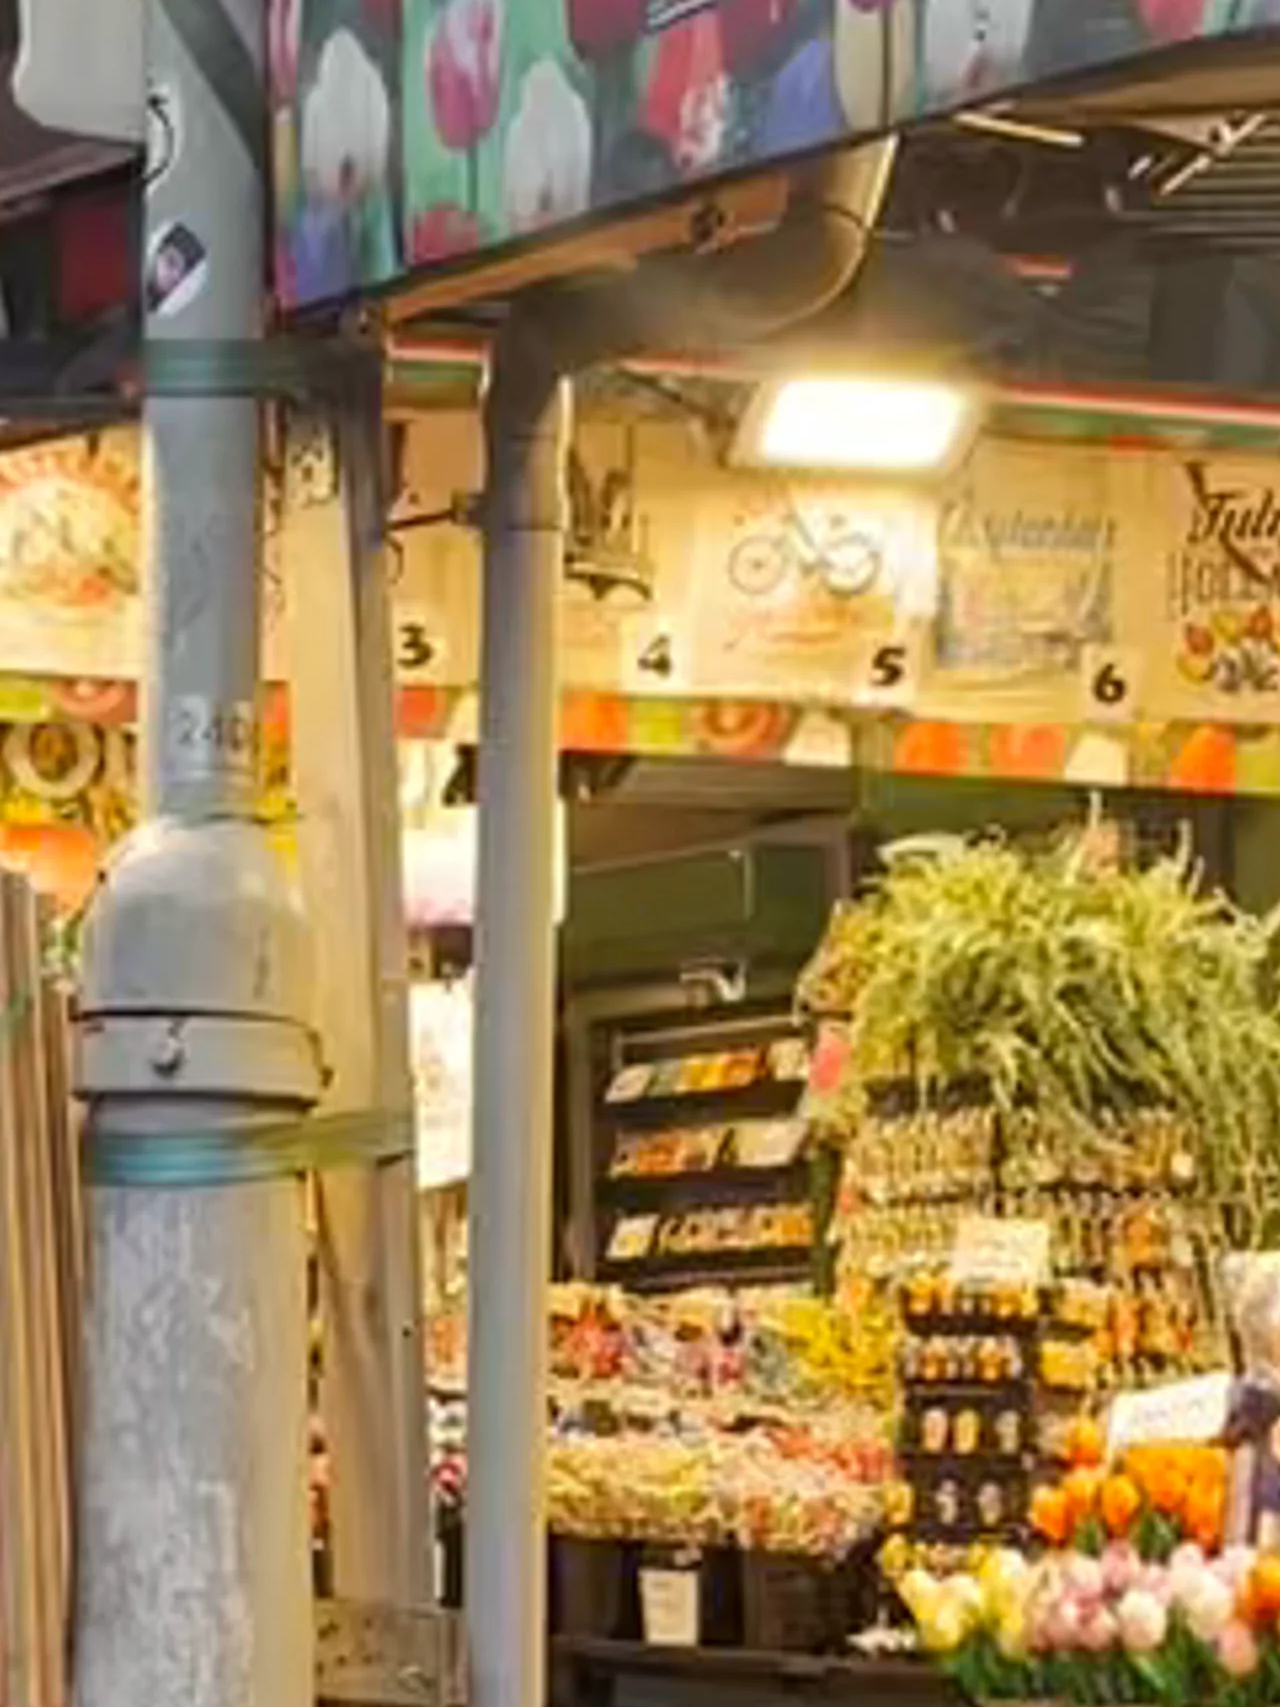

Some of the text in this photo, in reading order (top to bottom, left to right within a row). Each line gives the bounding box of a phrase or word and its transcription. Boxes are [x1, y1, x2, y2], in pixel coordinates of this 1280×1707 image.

[397, 624, 434, 669] 3
[637, 634, 672, 677] 4
[869, 645, 907, 687] 5
[1091, 662, 1128, 707] 6
